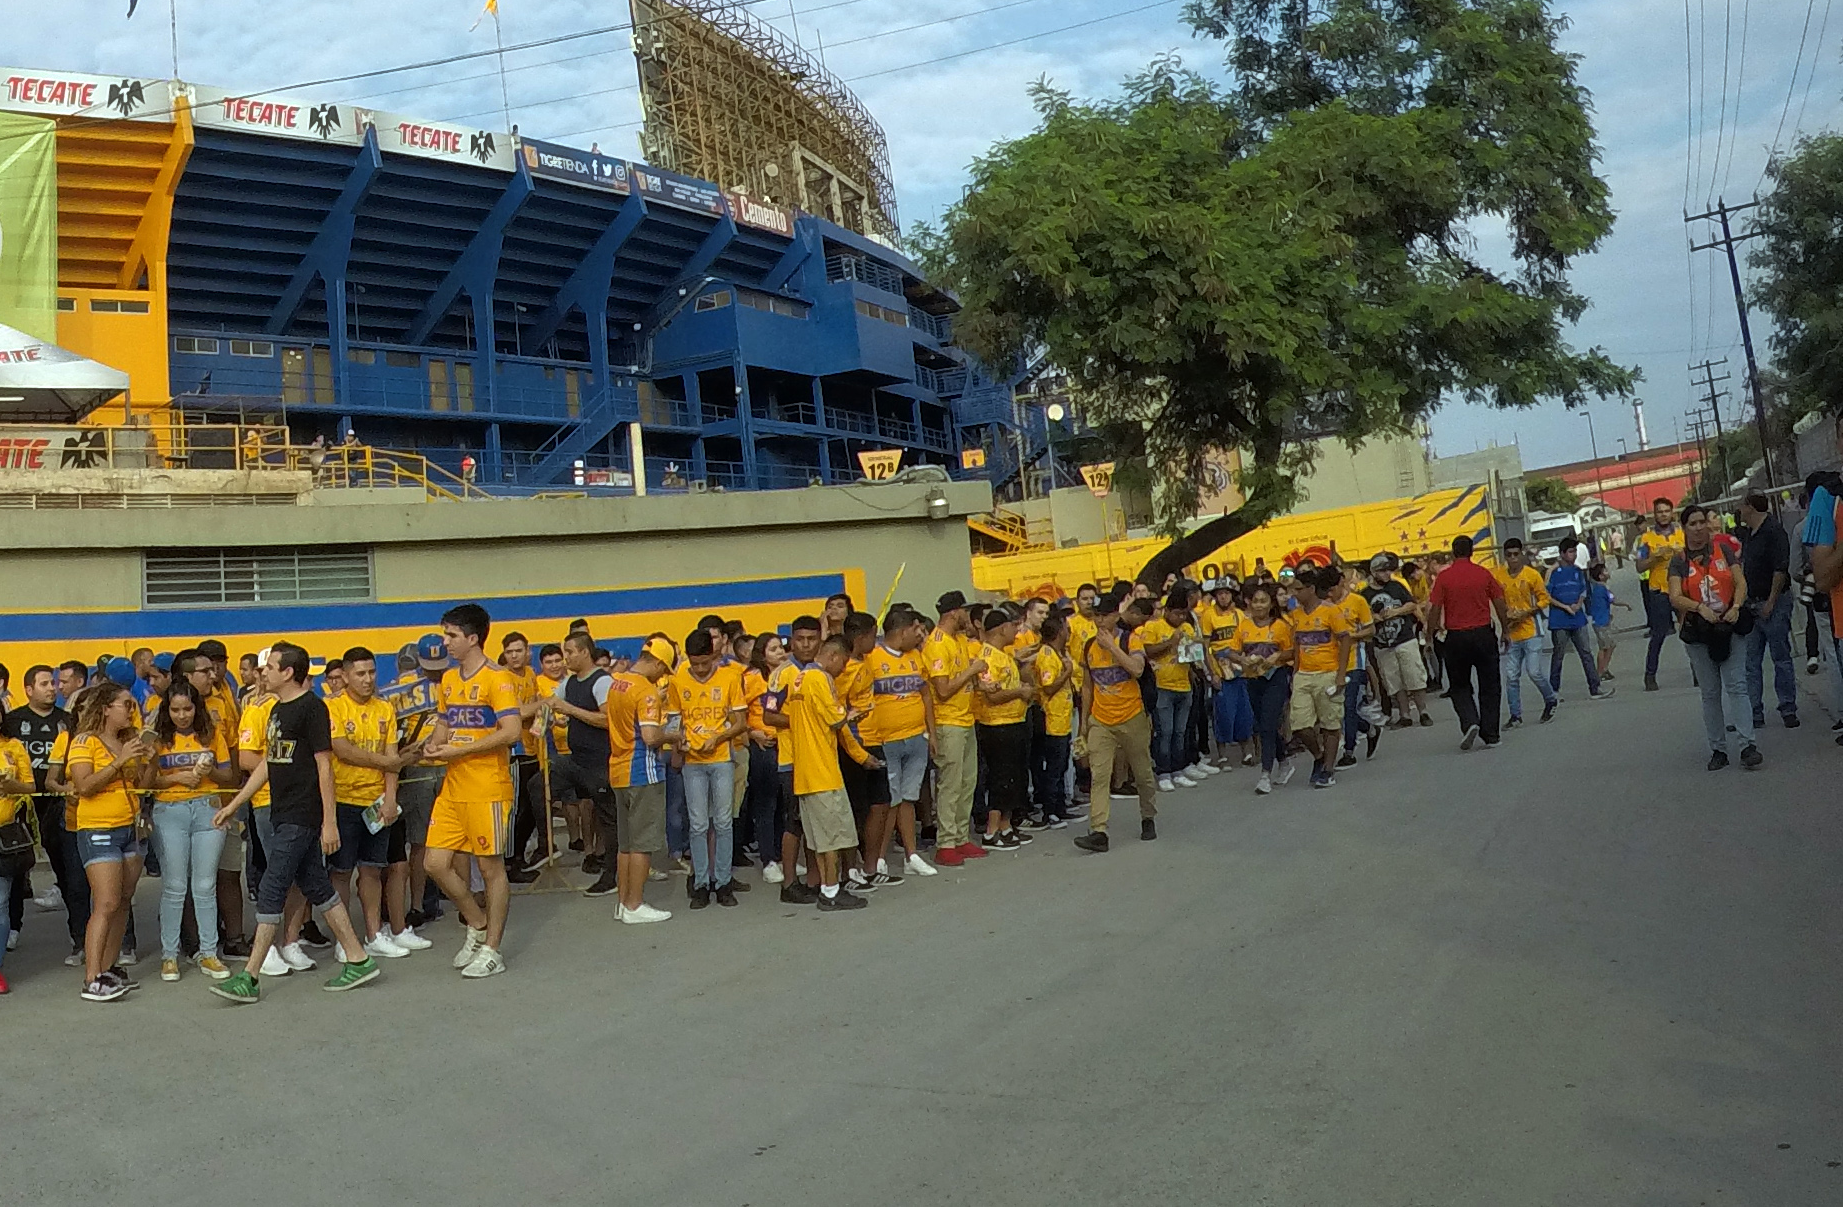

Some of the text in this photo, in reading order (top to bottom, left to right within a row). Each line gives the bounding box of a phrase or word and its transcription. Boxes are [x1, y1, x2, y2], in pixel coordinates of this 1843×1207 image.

[5, 75, 98, 108] TECATE
[221, 96, 300, 130] TECATE
[397, 121, 464, 155] TECATE
[741, 195, 788, 233] Cemento
[878, 676, 925, 692] TIGRE
[447, 707, 485, 726] GRES
